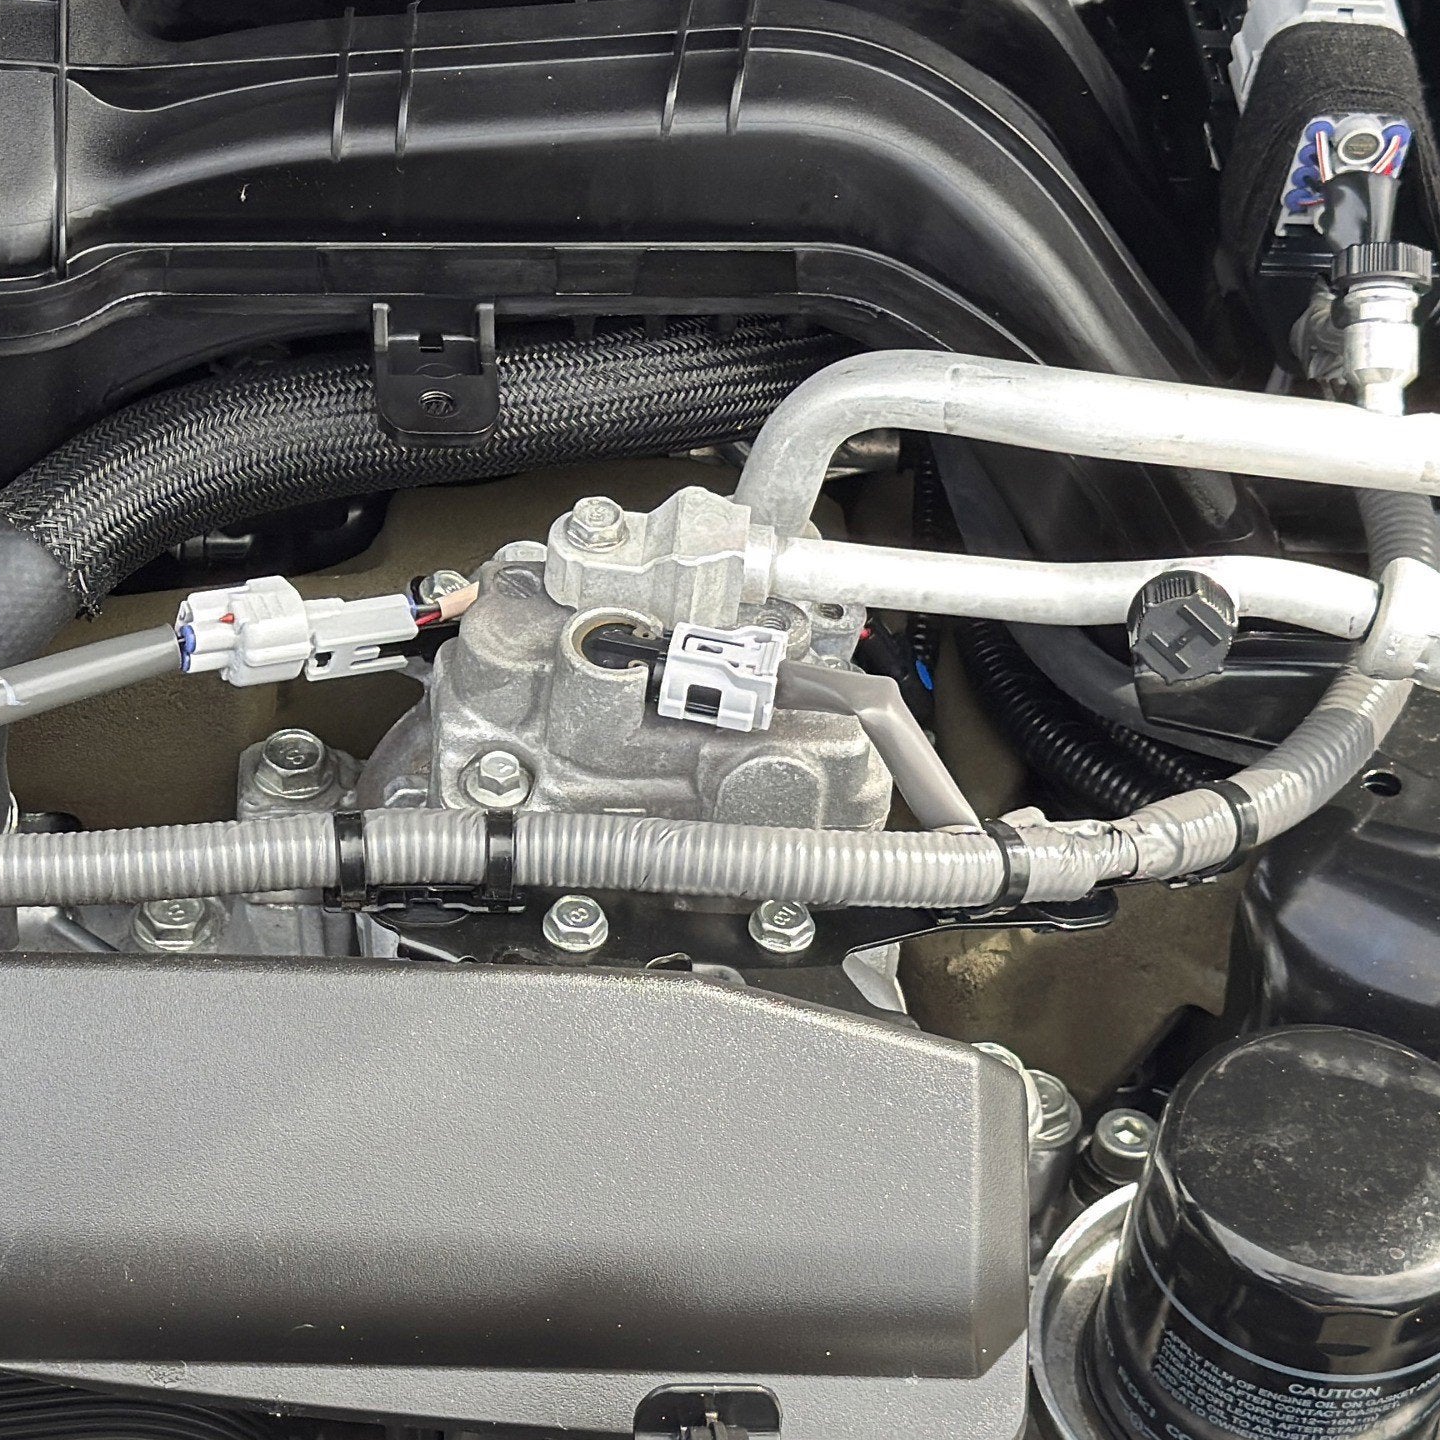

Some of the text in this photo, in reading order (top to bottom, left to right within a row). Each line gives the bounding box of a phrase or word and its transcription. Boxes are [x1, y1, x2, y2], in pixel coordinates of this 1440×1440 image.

[1203, 1360, 1235, 1383] FILM
[1236, 1379, 1256, 1392] OF
[1258, 1388, 1312, 1408] ENGINE
[1314, 1401, 1337, 1410] OIL
[1341, 1401, 1364, 1410] ON
[1226, 1385, 1272, 1408] AFTER
[1274, 1402, 1342, 1418] CONTACT
[1288, 1383, 1381, 1399] CAUTION
[1179, 1385, 1205, 1406] ADD
[1206, 1403, 1228, 1420] OIL
[1233, 1415, 1250, 1428] TO
[1252, 1425, 1309, 1440] ADJUST
[1190, 1401, 1206, 1417] TO
[1198, 1388, 1225, 1407] FOR
[1279, 1422, 1324, 1435] AFTER
